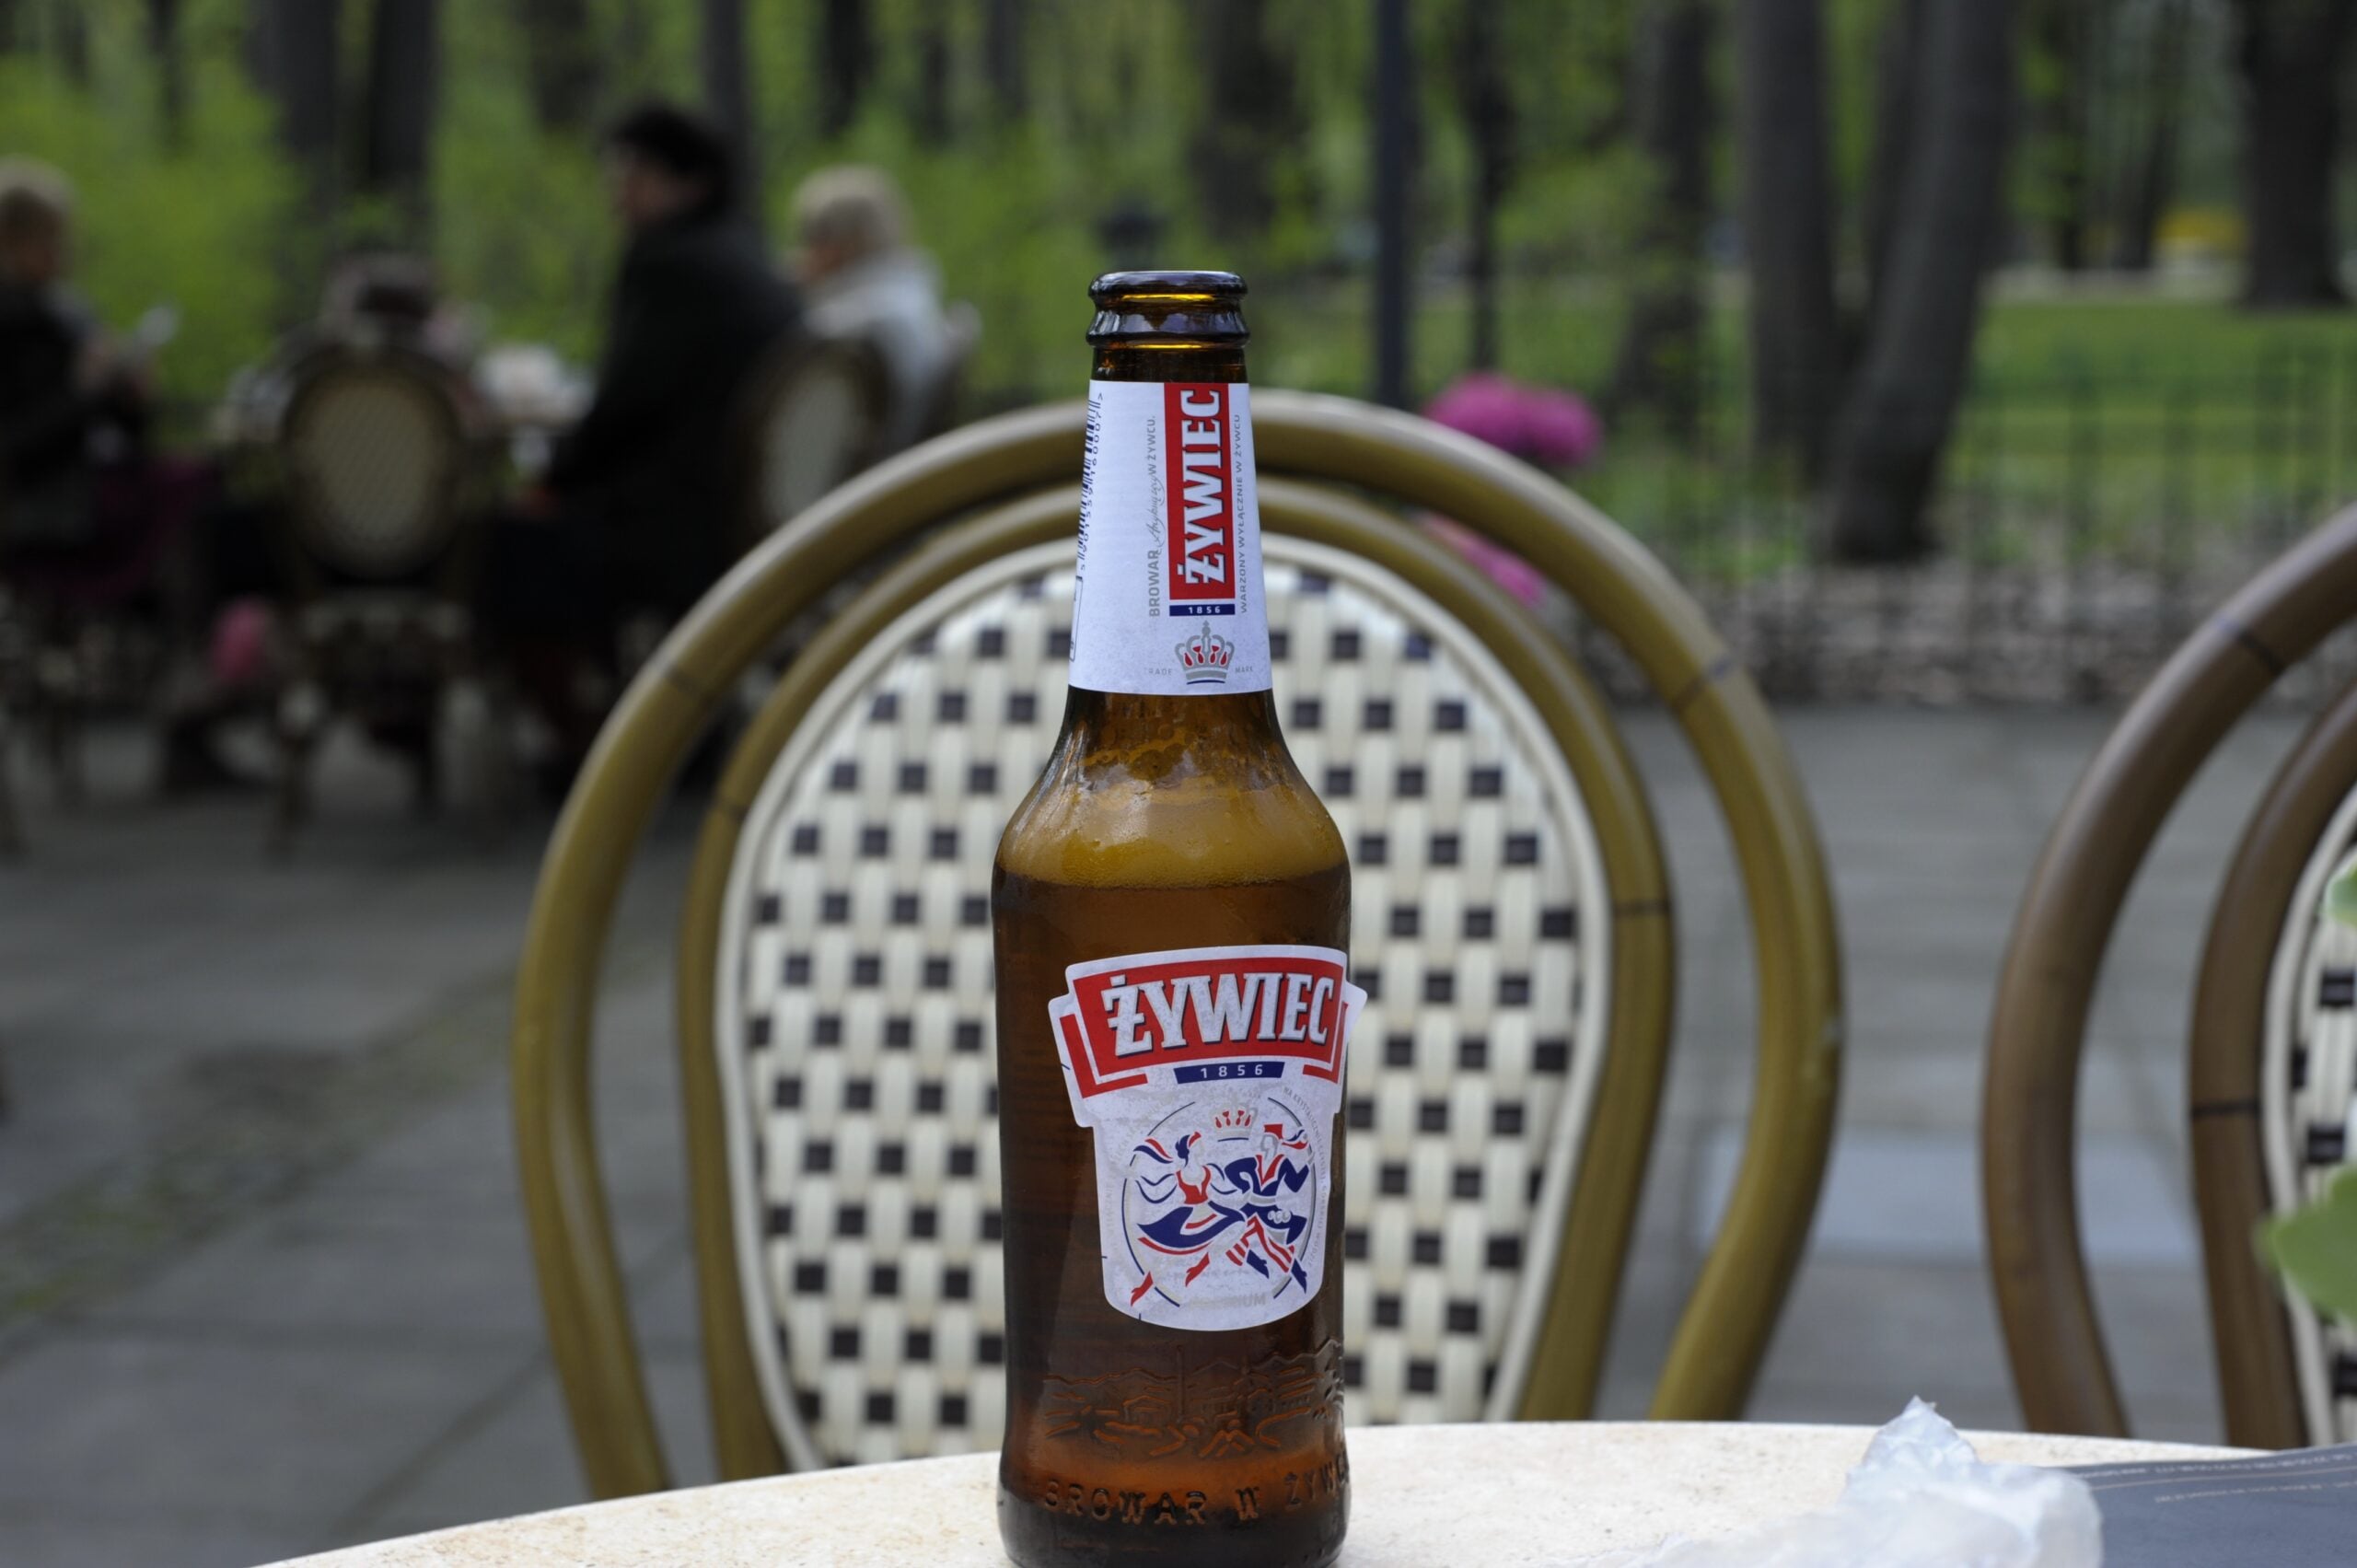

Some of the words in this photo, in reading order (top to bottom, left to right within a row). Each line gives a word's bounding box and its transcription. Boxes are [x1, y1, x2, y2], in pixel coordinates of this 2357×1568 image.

[1089, 411, 1102, 475] 160007
[1234, 414, 1242, 458] ŻYWCU
[1148, 463, 1157, 476] W
[1177, 389, 1225, 585] ŻYWIEC
[1236, 460, 1243, 473] W
[1236, 476, 1247, 549] WYŁĄCZNIE
[1147, 549, 1162, 617] BROWAR
[1238, 552, 1248, 614] WARZONY
[1188, 606, 1222, 615] 1856
[1100, 972, 1335, 1057] ŻYWIEC
[1200, 1064, 1263, 1079] 1856
[1044, 1479, 1207, 1526] BROWAR
[1235, 1486, 1260, 1522] W
